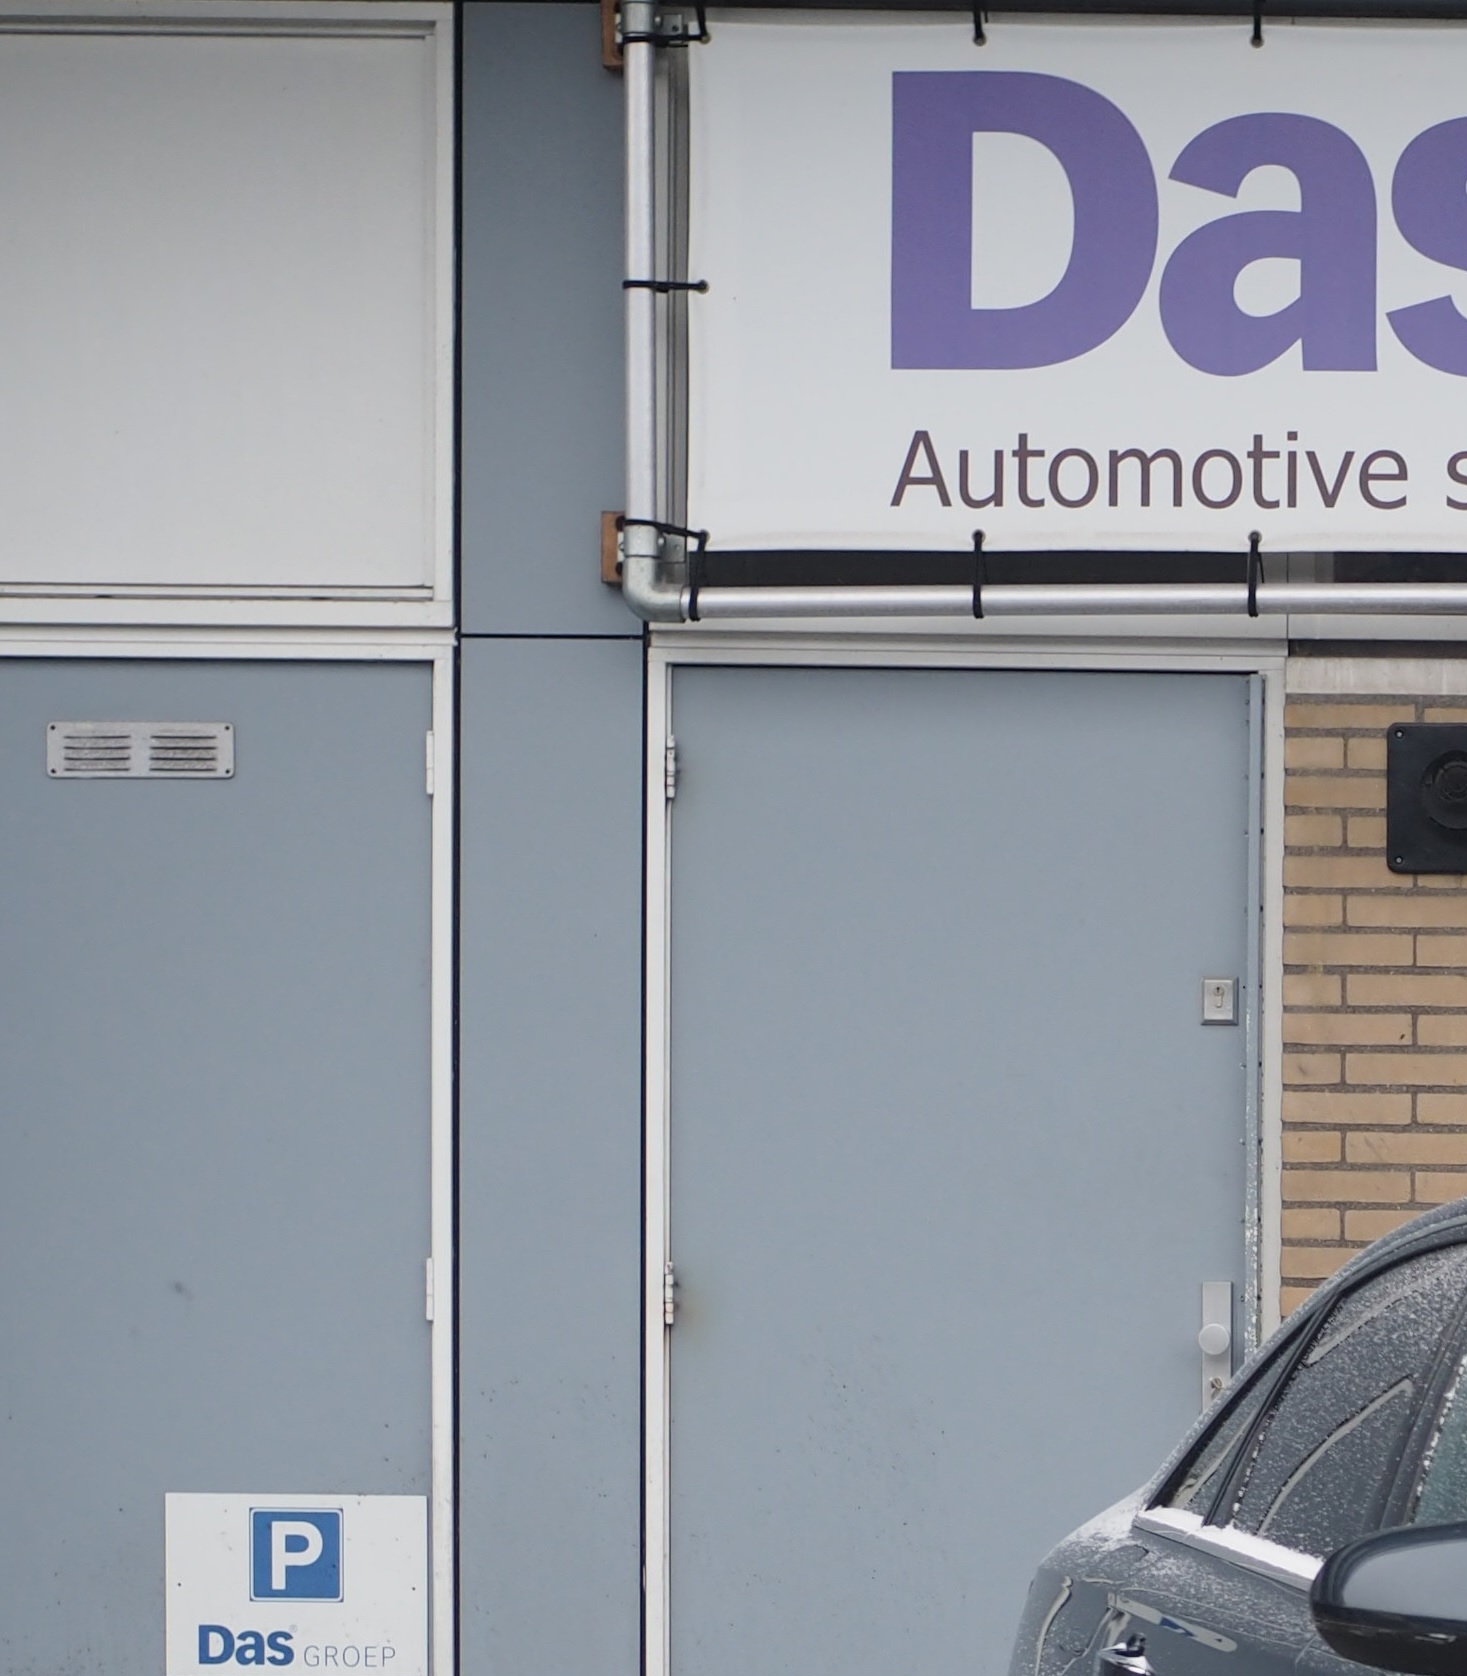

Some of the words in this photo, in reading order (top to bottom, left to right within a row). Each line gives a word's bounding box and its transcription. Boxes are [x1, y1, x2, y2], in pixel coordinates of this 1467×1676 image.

[889, 429, 1409, 511] Automotive
[271, 1520, 323, 1590] P
[198, 1624, 296, 1667] Das
[303, 1645, 397, 1668] GROEP
